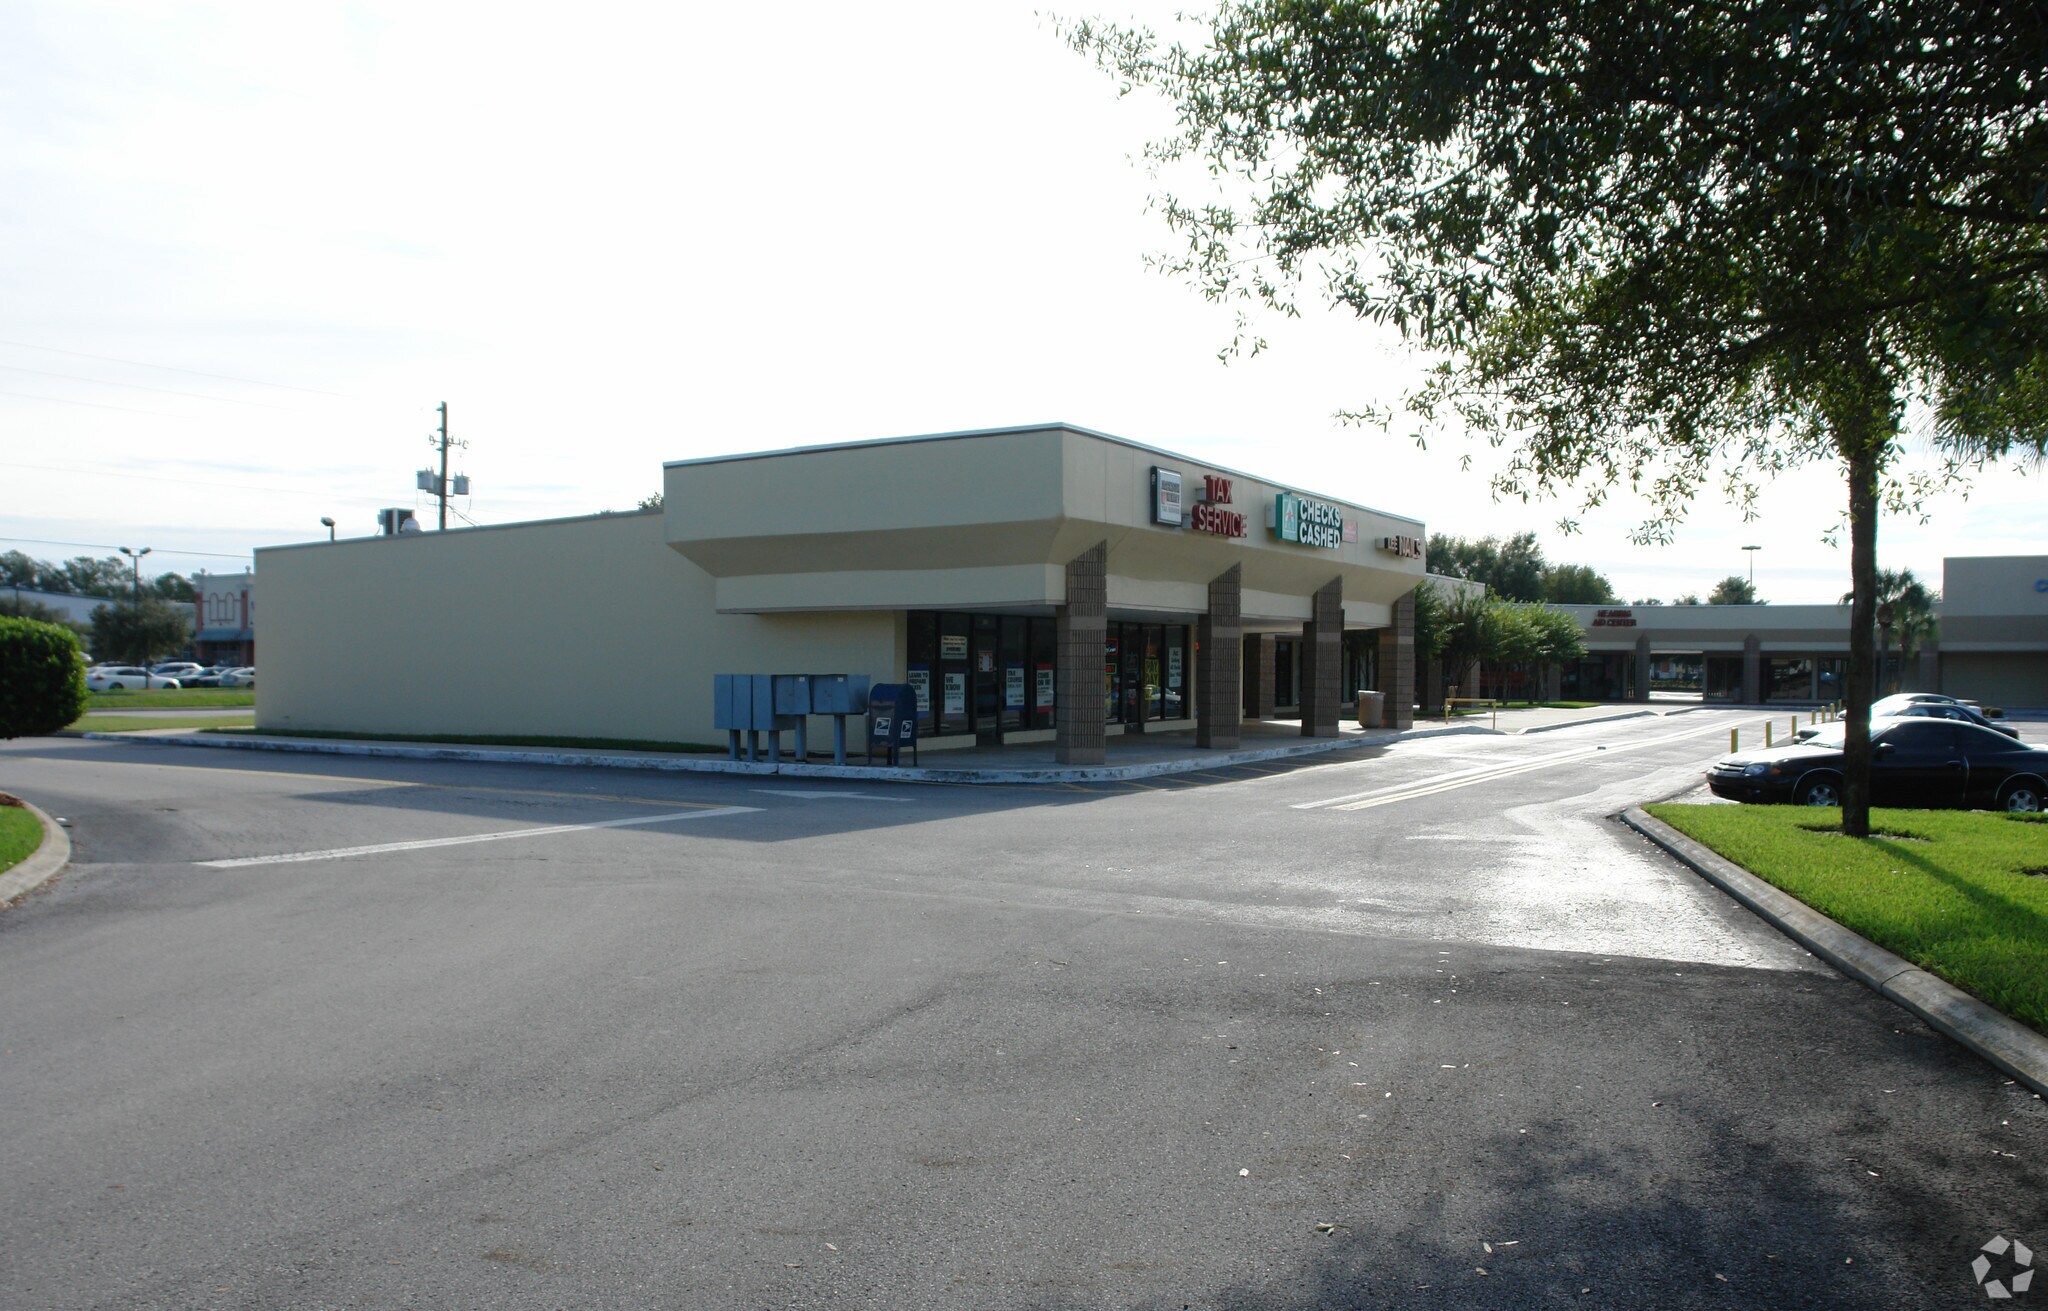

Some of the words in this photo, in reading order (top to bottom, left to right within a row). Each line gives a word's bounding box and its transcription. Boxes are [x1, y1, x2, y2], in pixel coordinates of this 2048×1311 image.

[1209, 476, 1234, 503] TAX
[1198, 504, 1248, 538] SERVICE
[1300, 498, 1341, 528] CHECKS
[1299, 521, 1341, 549] CASHED
[1398, 536, 1421, 559] NAILS
[1607, 618, 1637, 627] CENTER
